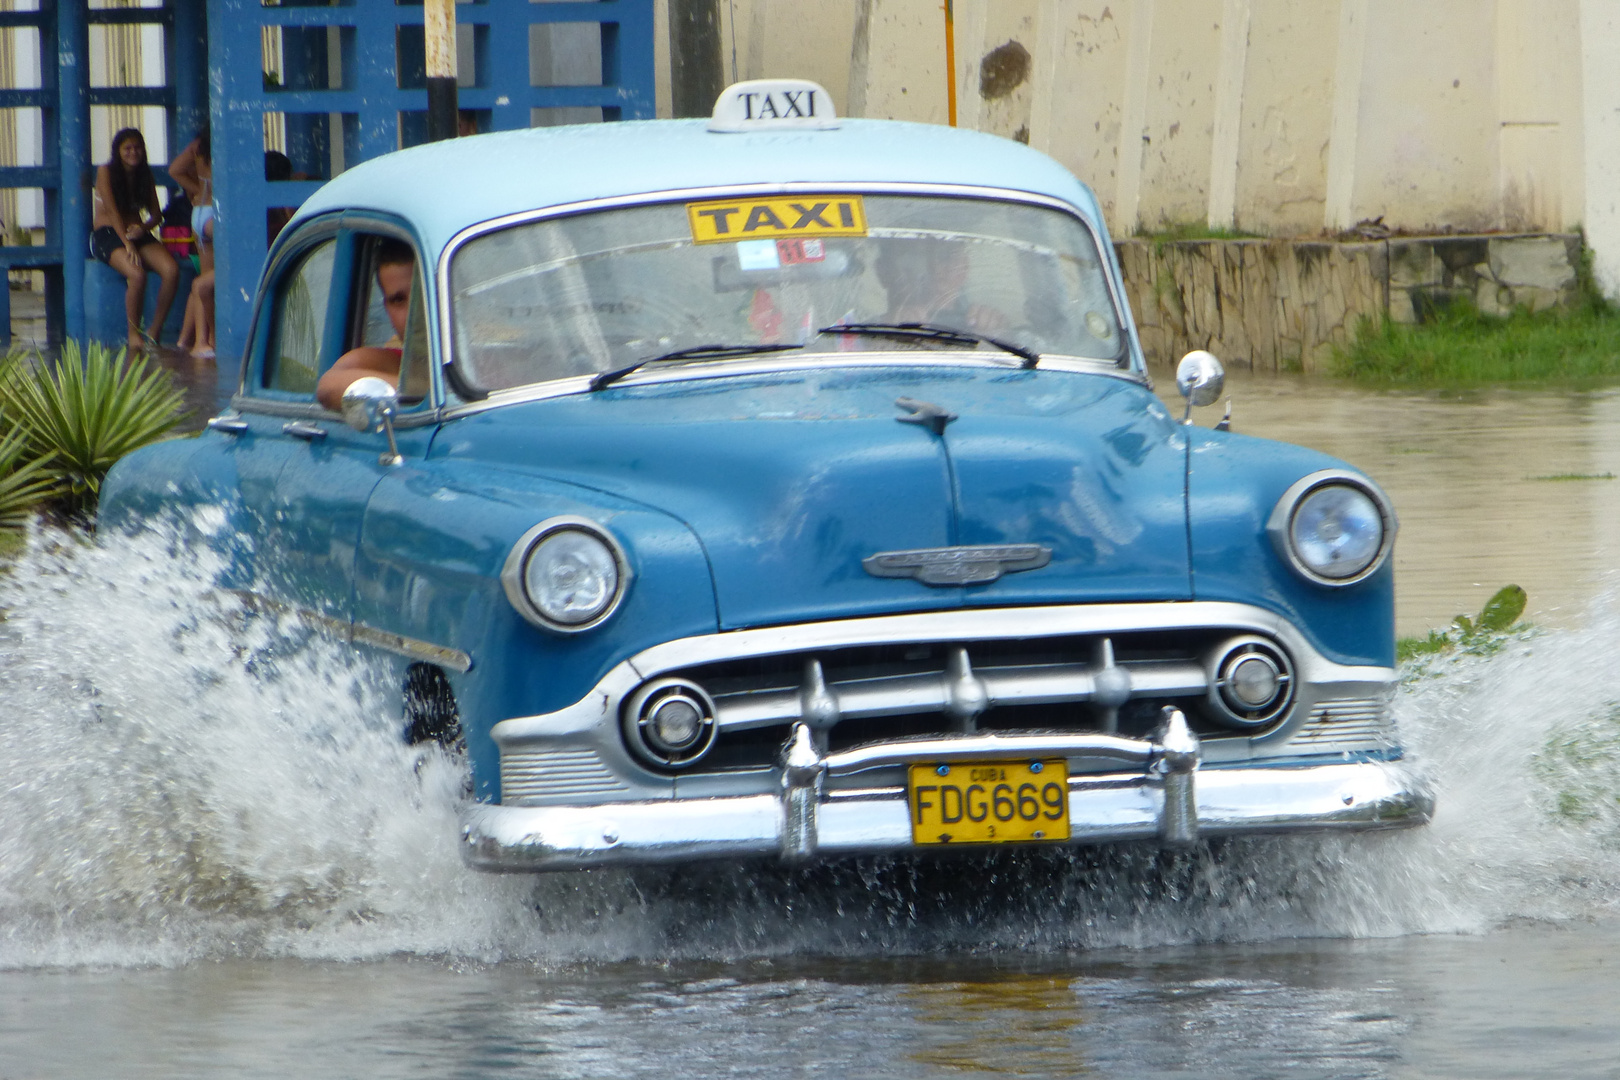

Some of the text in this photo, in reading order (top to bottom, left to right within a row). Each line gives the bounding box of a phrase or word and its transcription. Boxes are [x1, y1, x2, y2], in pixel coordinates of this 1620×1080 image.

[737, 90, 817, 120] TAXI
[698, 203, 855, 235] TAXI
[969, 768, 1008, 782] CUBA
[915, 782, 1064, 825] FDG669
[986, 825, 996, 838] 3
